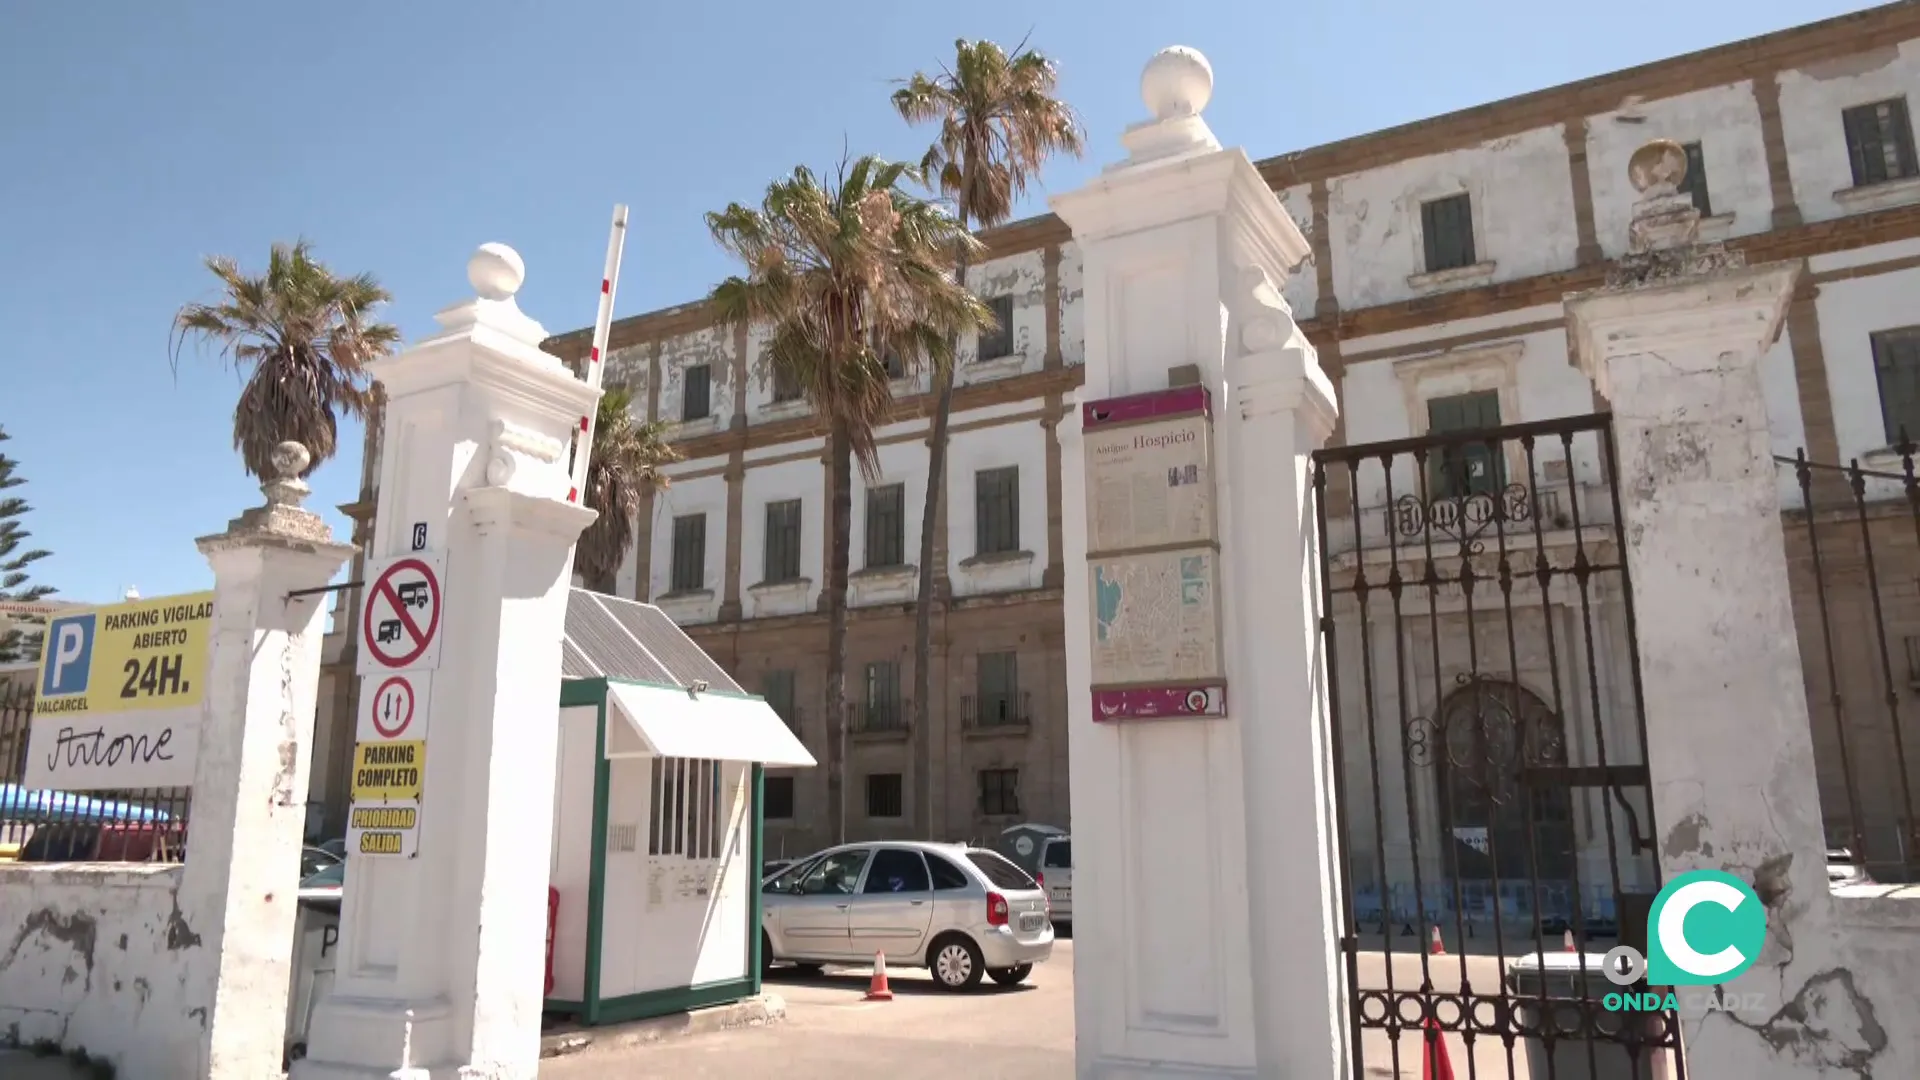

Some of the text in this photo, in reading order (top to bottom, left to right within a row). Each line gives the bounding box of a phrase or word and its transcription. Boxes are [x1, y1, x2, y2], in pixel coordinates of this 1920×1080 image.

[1133, 428, 1196, 450] Hospicio
[414, 524, 427, 549] 6
[104, 611, 159, 631] PARKING
[132, 628, 188, 650] ABIERTO
[52, 622, 84, 689] P
[120, 653, 190, 698] 24H.
[36, 697, 89, 714] VALCARCEL
[363, 744, 415, 764] PARKING
[357, 767, 418, 787] COMPLETO
[351, 807, 416, 829] PRIORIDAD
[360, 831, 402, 853] SALIDA
